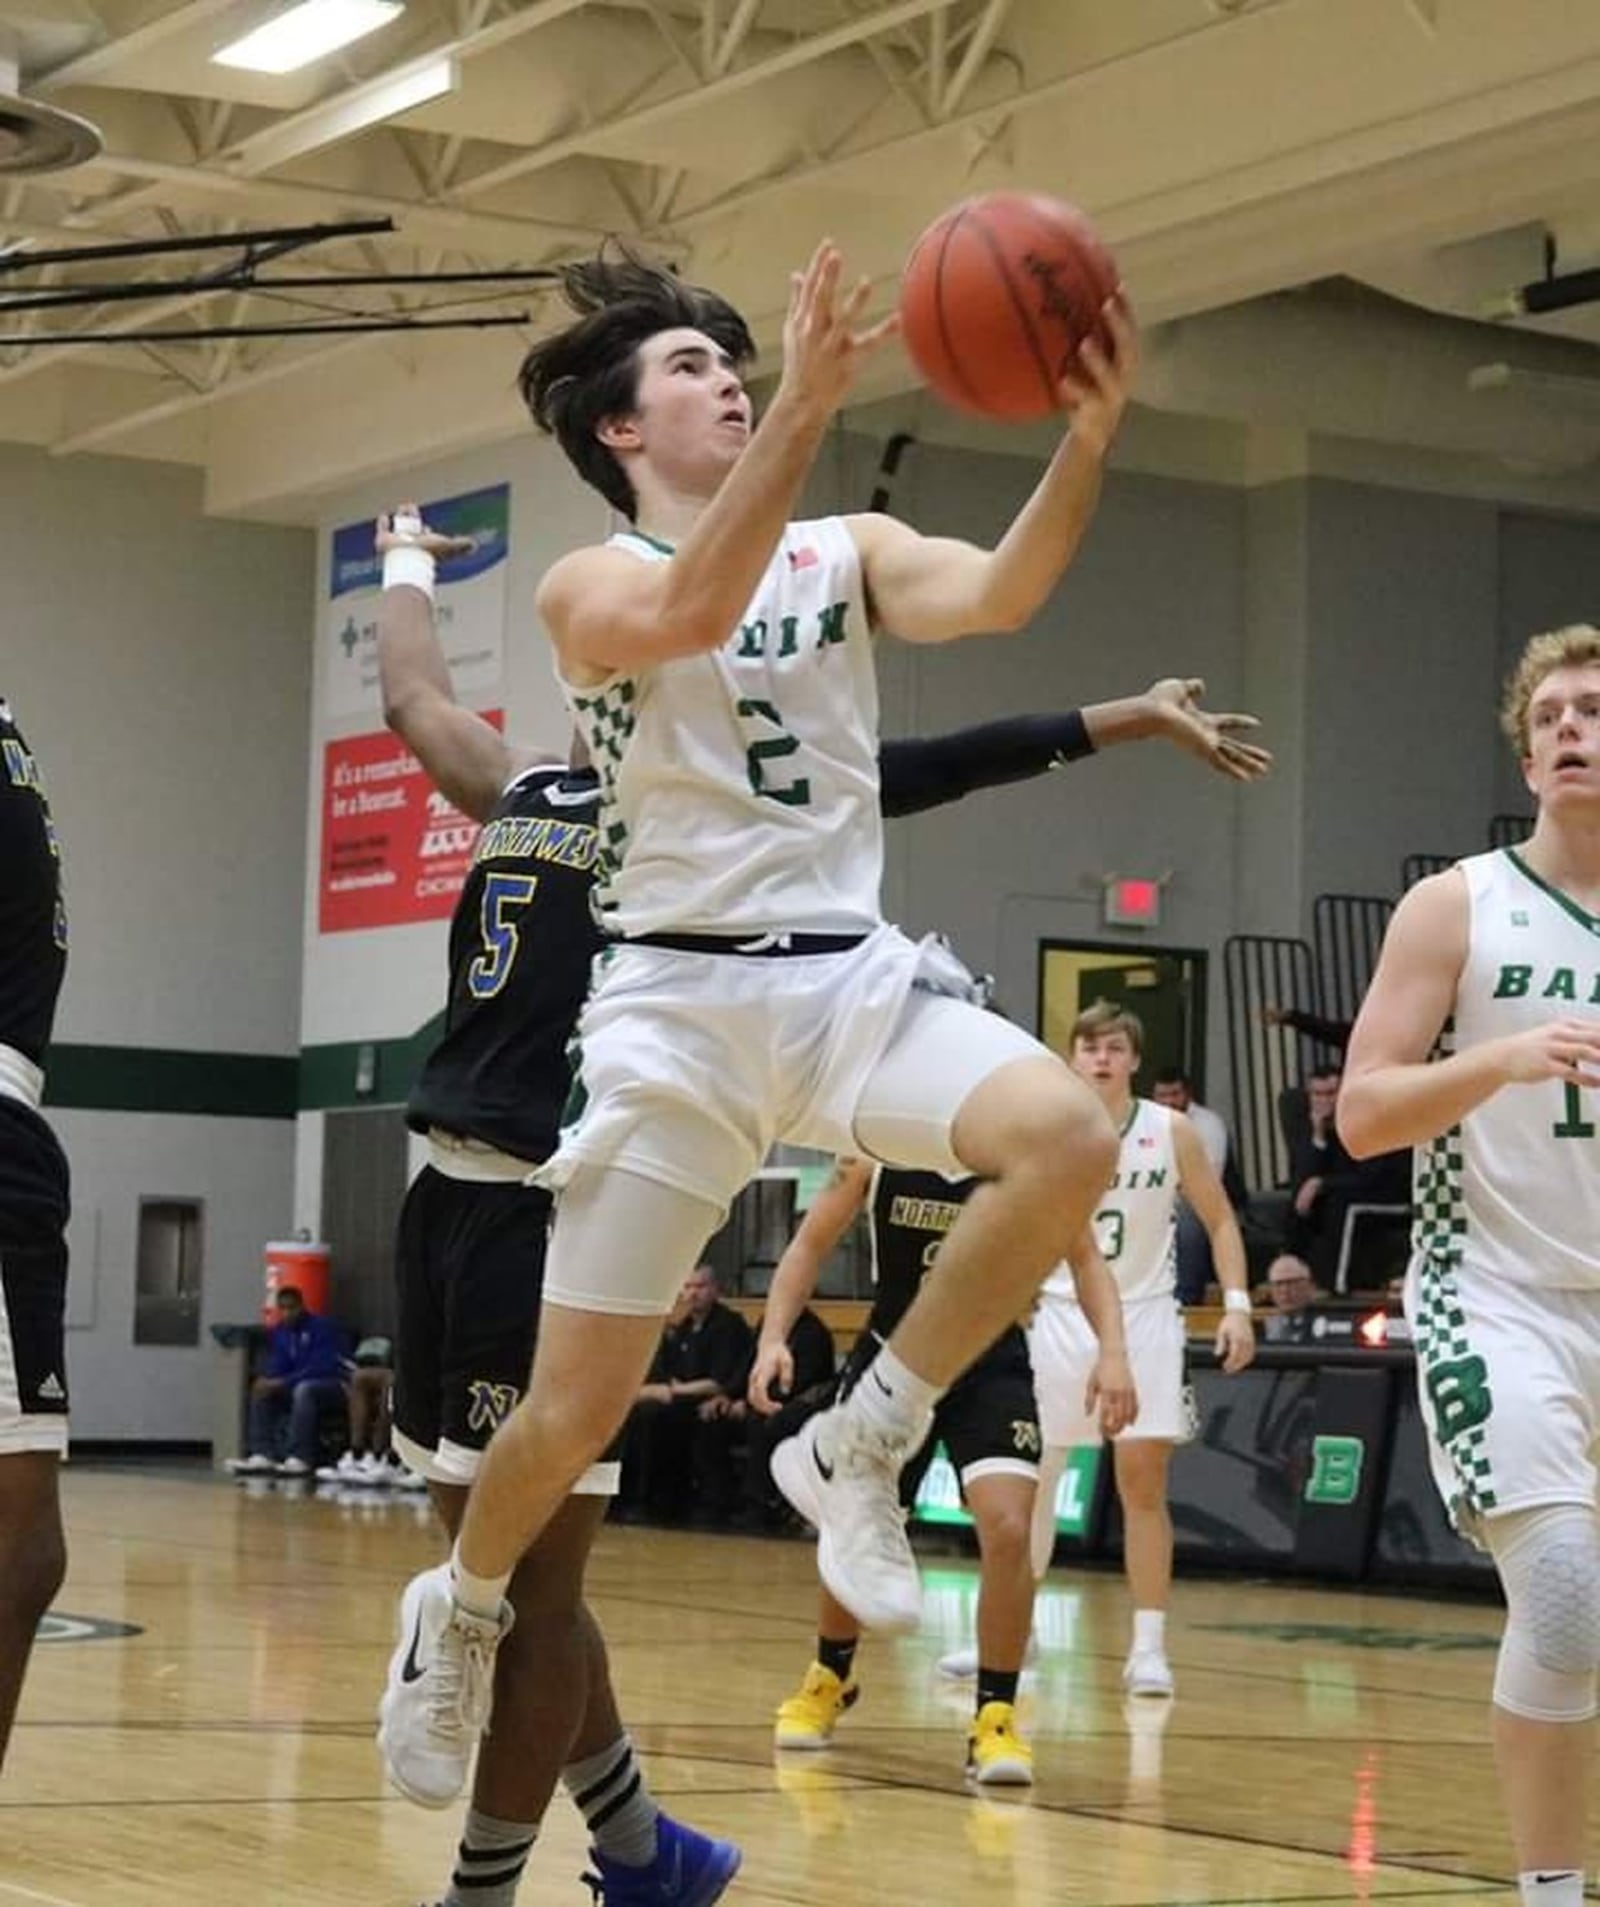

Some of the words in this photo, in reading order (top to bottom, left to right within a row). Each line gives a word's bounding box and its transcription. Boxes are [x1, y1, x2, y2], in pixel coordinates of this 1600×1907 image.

[737, 699, 810, 806] 2
[468, 872, 538, 998] 5
[1096, 1209, 1124, 1261] 3
[1305, 1435, 1365, 1503] B
